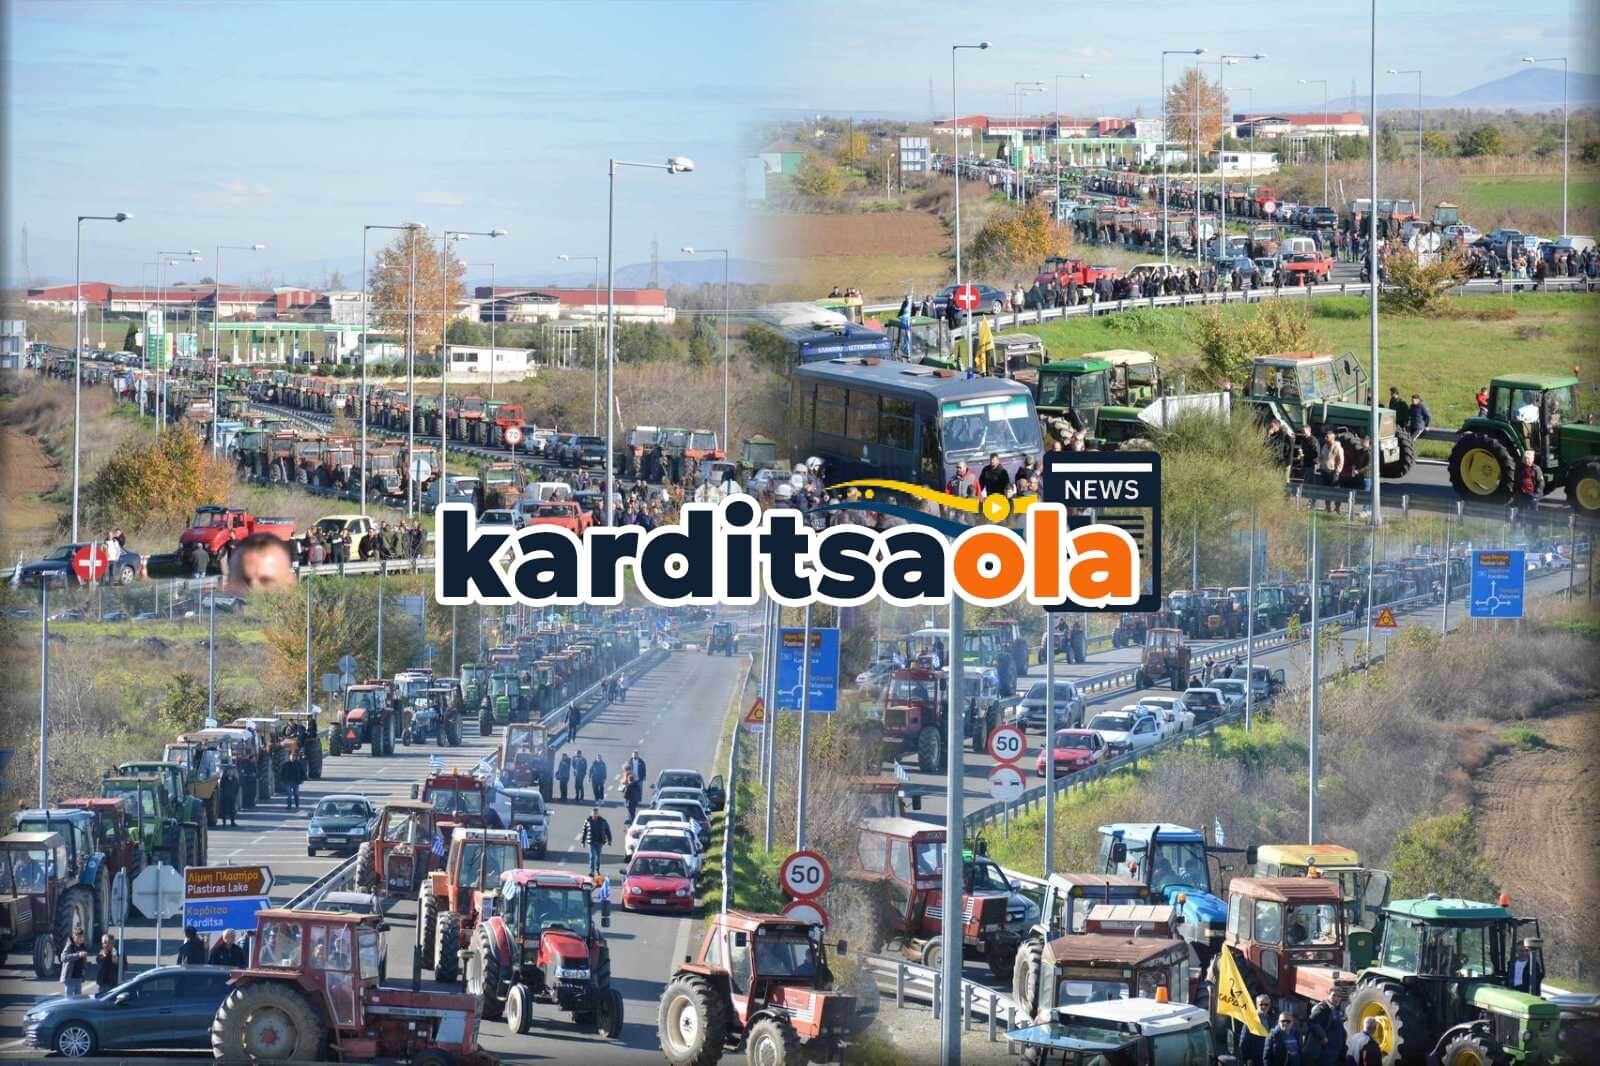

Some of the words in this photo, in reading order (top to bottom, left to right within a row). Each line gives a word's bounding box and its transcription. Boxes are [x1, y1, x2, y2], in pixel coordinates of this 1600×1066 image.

[996, 736, 1018, 751] 50
[791, 865, 820, 884] 50
[187, 883, 225, 894] Plastiras
[227, 882, 249, 892] Lake
[186, 917, 224, 927] Karditsa
